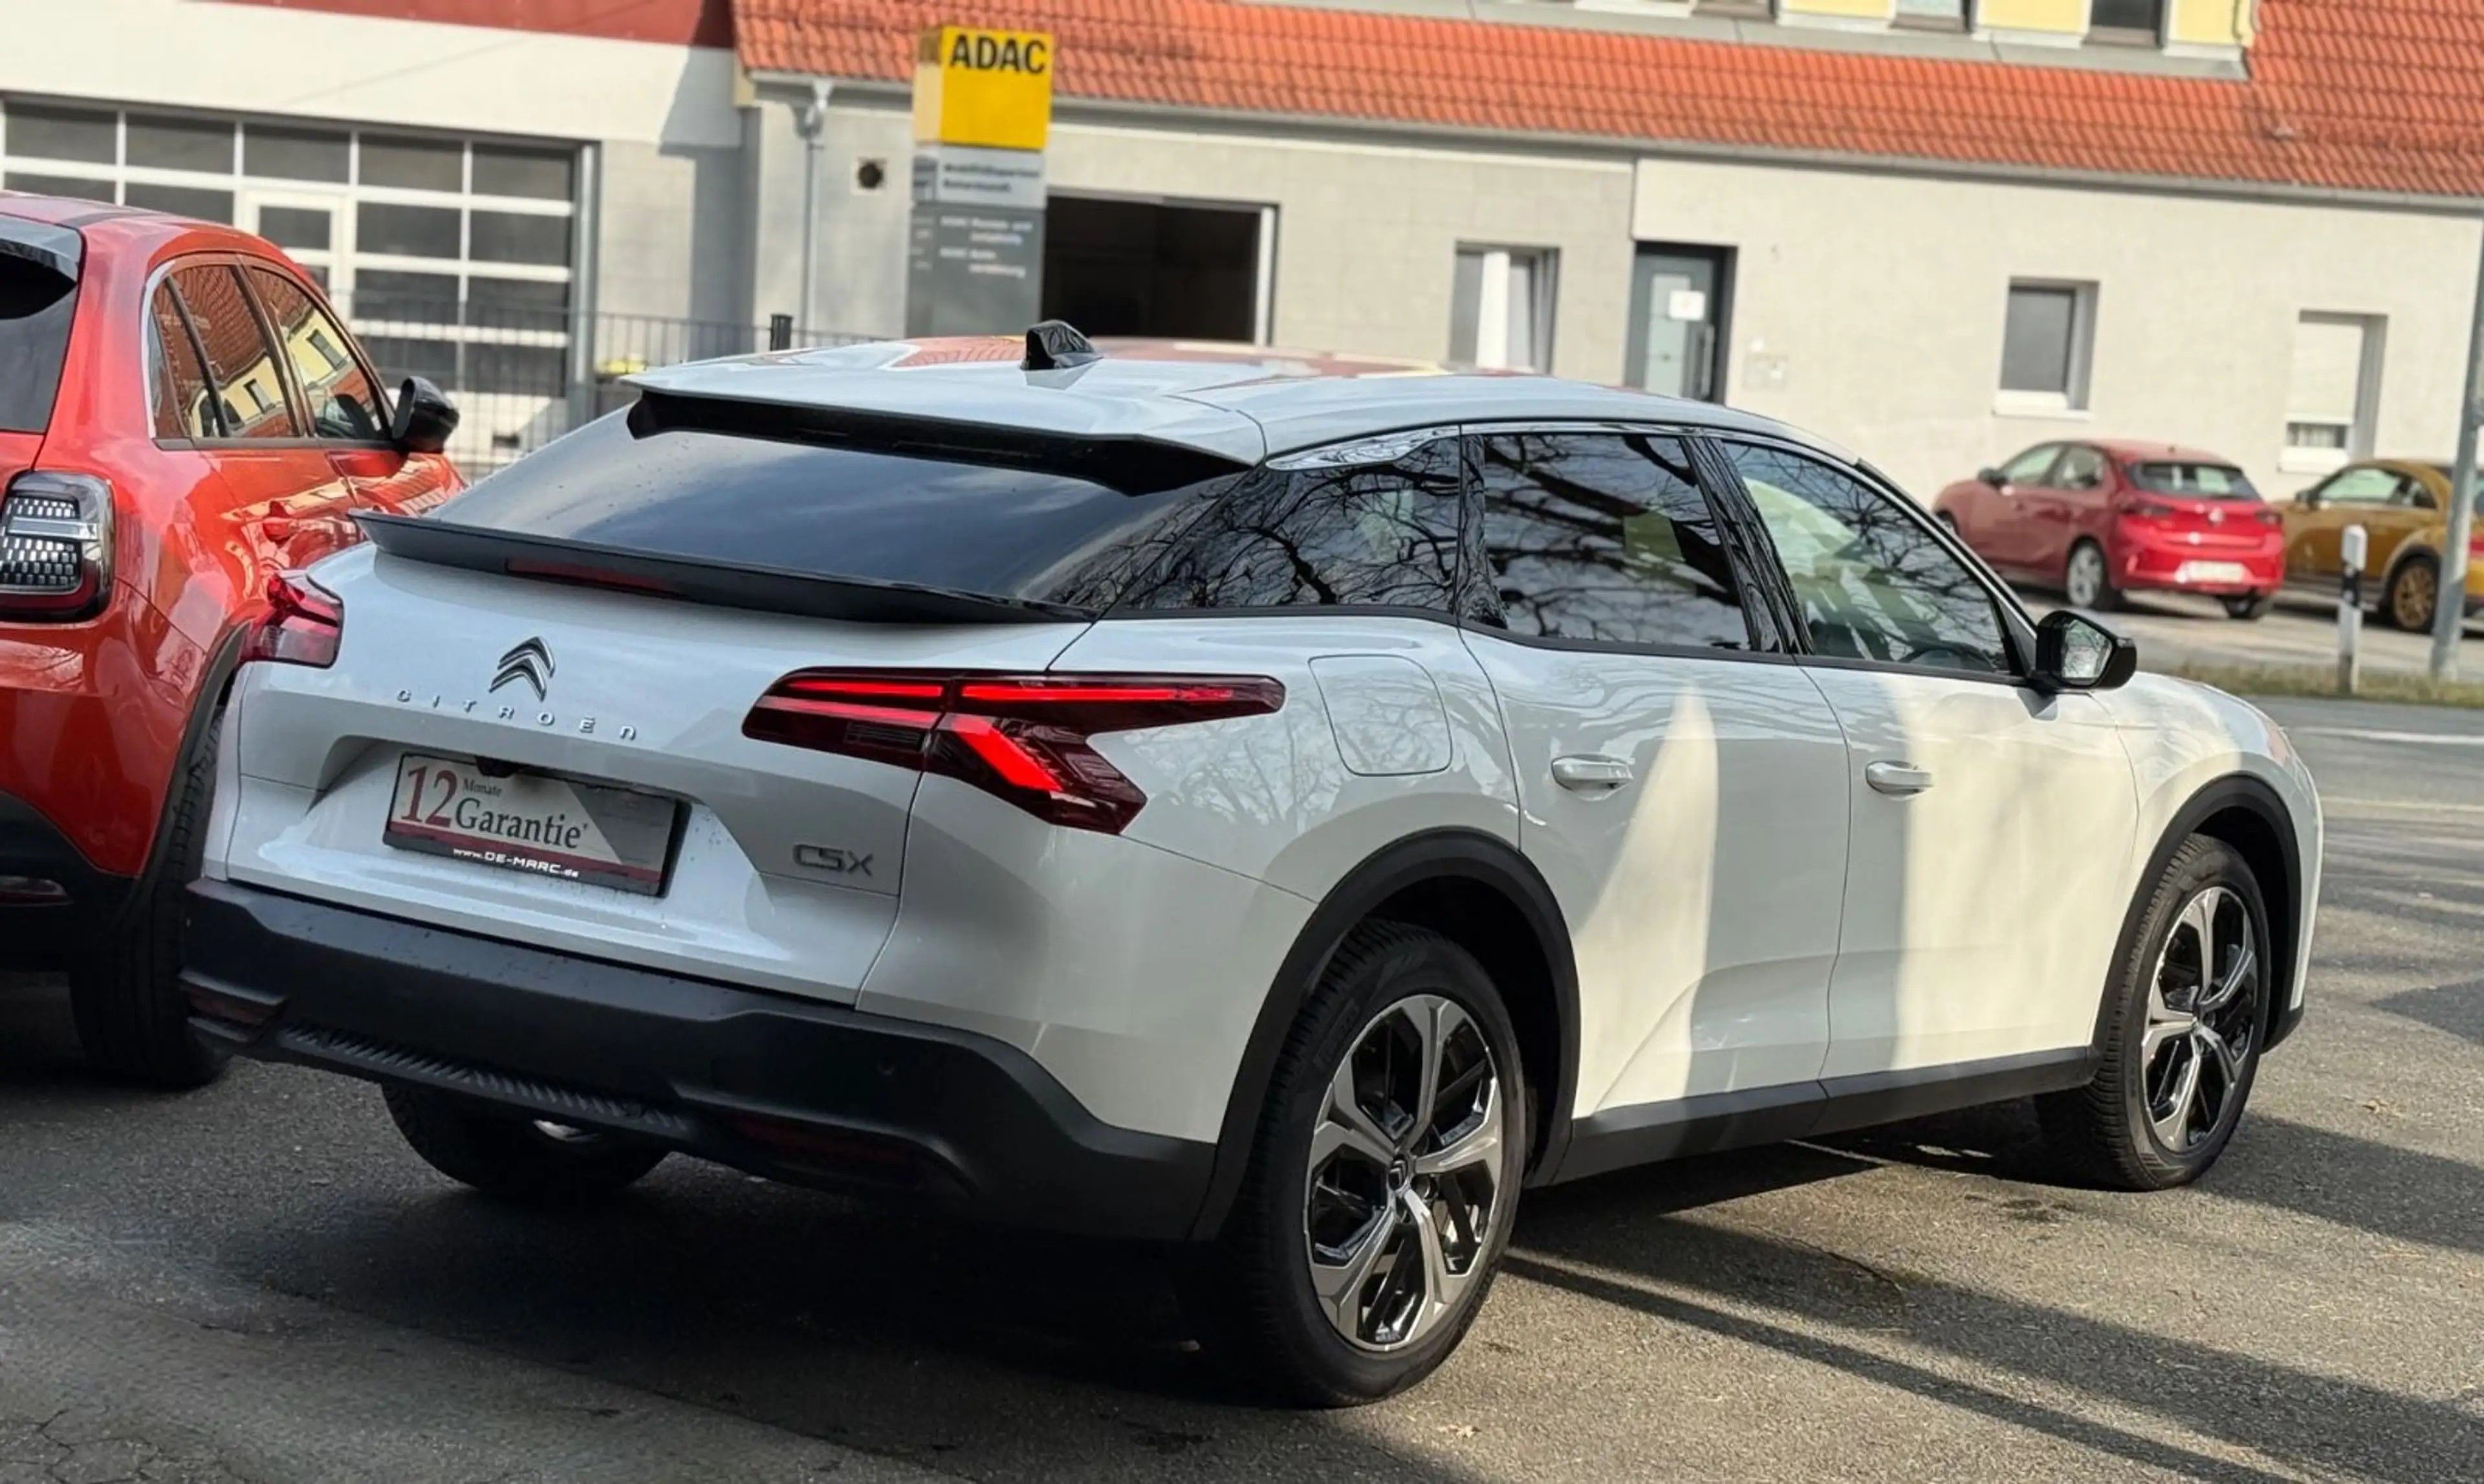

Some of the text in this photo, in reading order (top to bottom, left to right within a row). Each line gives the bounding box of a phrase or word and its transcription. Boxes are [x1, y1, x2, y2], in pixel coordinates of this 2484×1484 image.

[949, 34, 1046, 74] ADAC
[401, 765, 502, 828] 12 Monate
